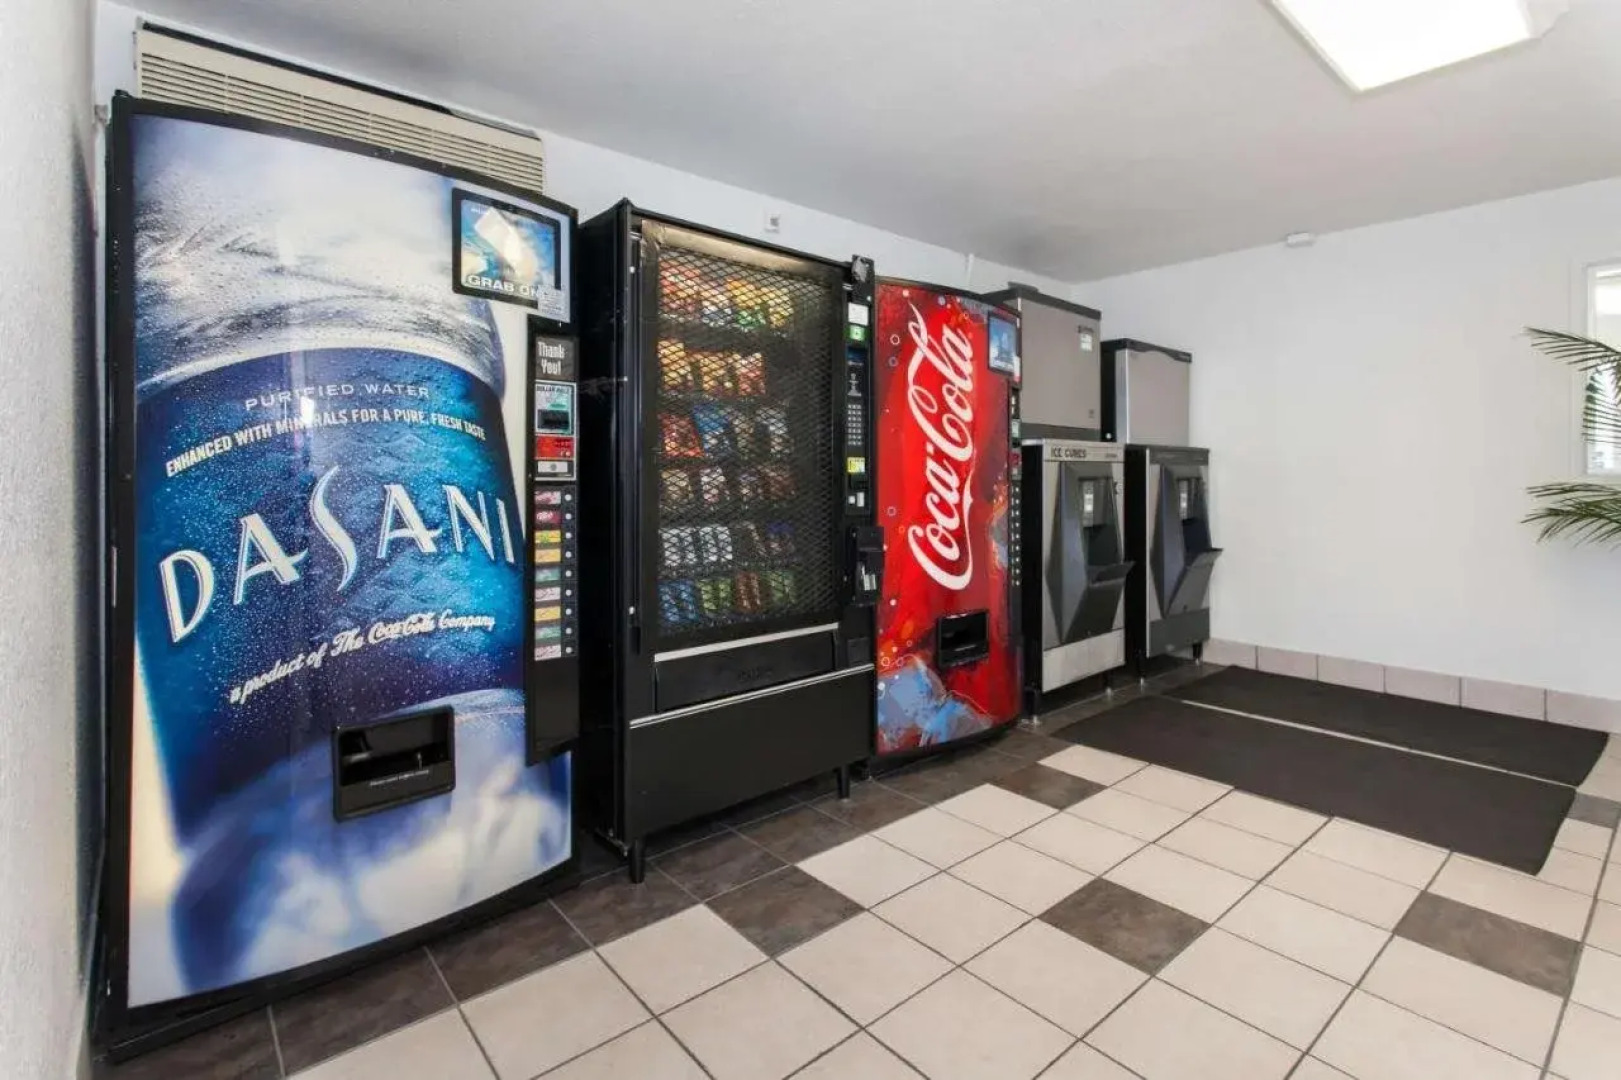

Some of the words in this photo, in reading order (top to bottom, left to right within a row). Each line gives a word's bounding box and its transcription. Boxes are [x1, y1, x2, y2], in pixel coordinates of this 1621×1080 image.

[468, 275, 515, 293] GRAB
[537, 341, 565, 359] Thank
[541, 358, 562, 376] You!
[245, 384, 354, 411] PURIFIED
[364, 384, 430, 399] WATER
[166, 435, 233, 478] ENHANCED
[234, 423, 272, 446] WITH
[275, 409, 348, 434] MINRALS
[352, 408, 380, 423] FOR
[382, 408, 393, 422] A
[431, 412, 463, 432] FRESH
[463, 420, 487, 441] TASTE
[907, 301, 974, 590] Coca-Cola
[159, 465, 514, 644] DASANI
[239, 653, 305, 704] product
[306, 642, 328, 668] of
[330, 625, 363, 657] The
[439, 609, 495, 632] Company
